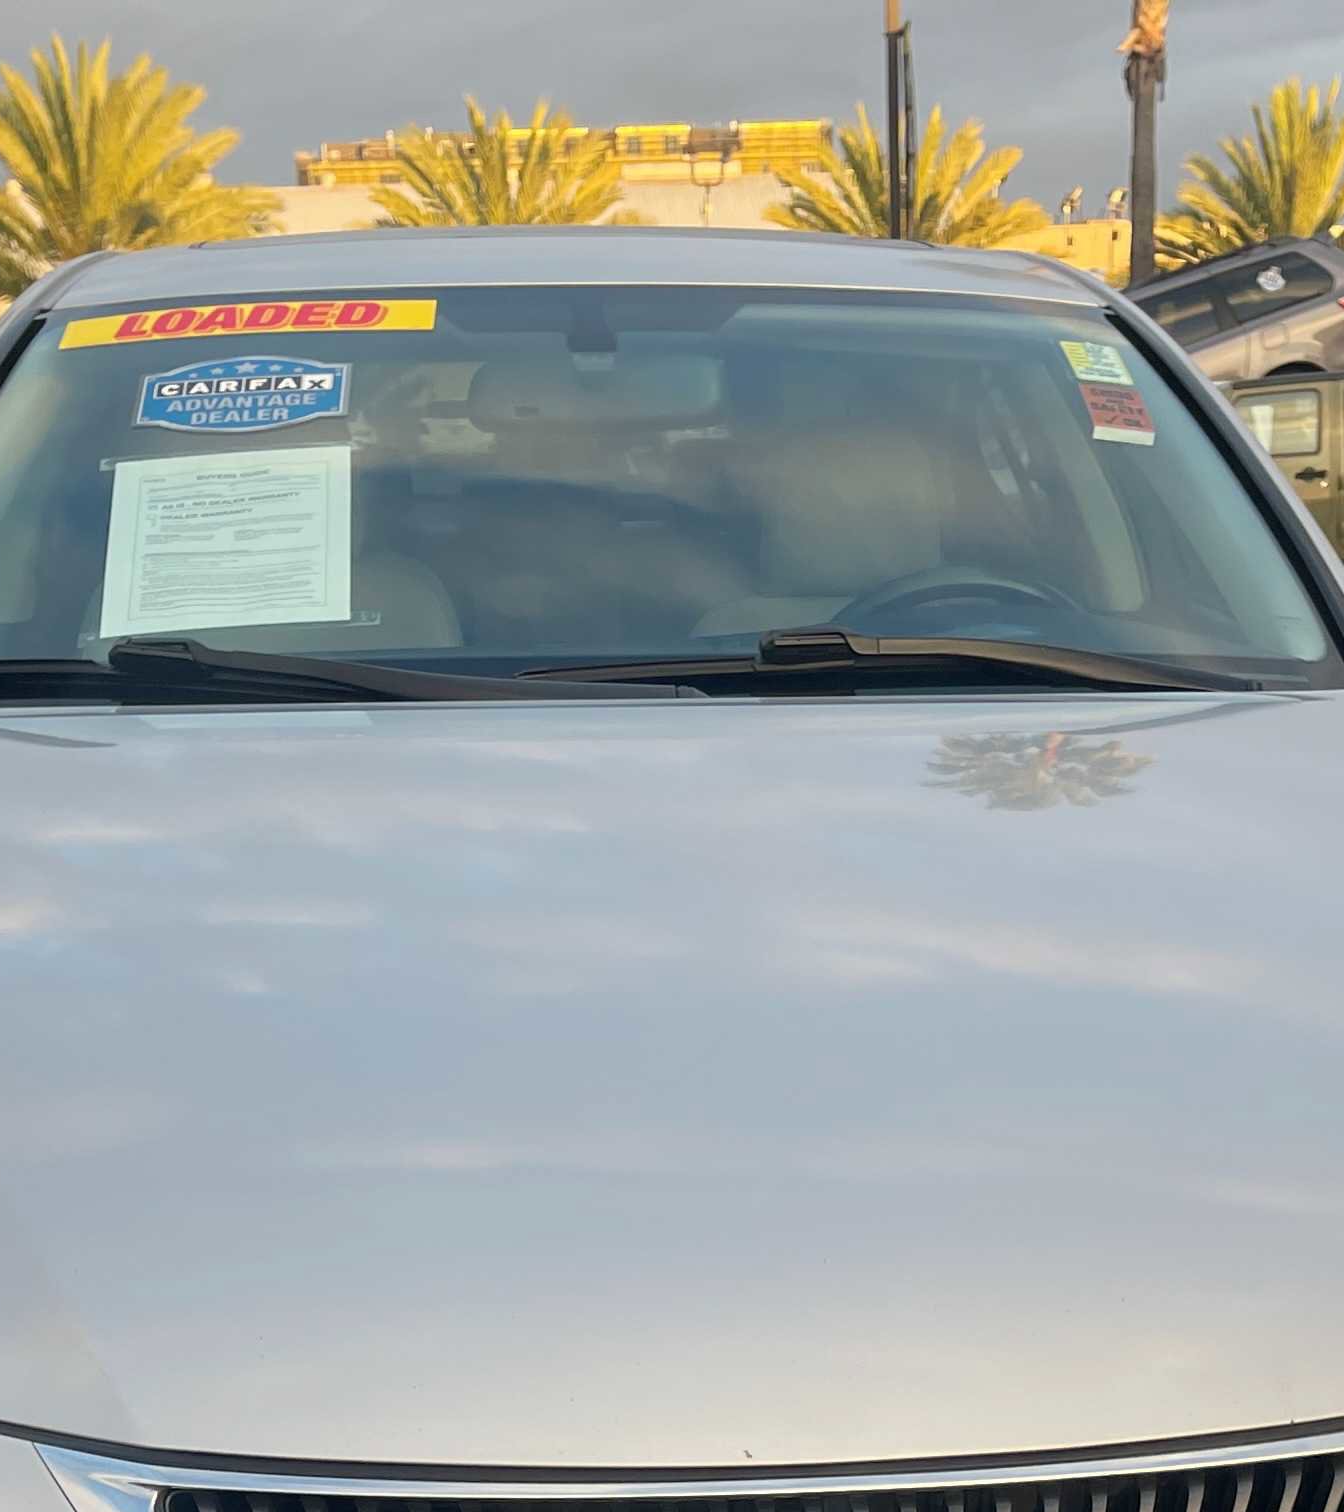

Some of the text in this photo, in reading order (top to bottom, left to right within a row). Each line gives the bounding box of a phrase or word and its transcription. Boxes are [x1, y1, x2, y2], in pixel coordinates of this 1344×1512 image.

[114, 301, 389, 340] LOADED
[154, 373, 334, 400] CARFAX
[166, 393, 317, 413] ADVANTAGE
[189, 407, 290, 425] DEALER
